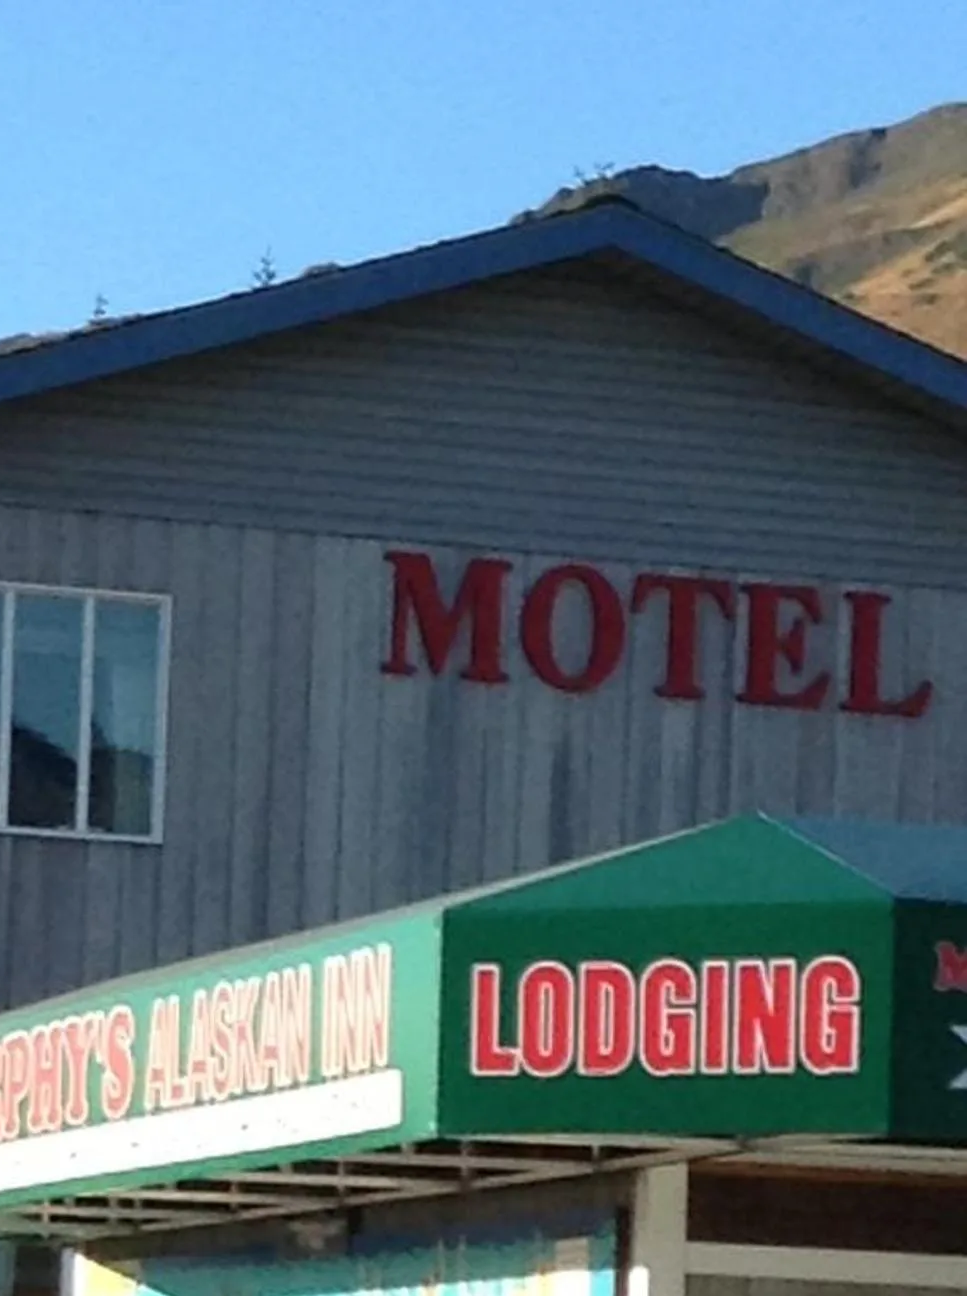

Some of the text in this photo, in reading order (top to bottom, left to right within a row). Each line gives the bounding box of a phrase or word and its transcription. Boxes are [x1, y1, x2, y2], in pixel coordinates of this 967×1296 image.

[381, 551, 934, 717] MOTEL
[144, 964, 310, 1109] ALASKAN
[321, 943, 391, 1076] INN
[471, 956, 860, 1077] LODGING
